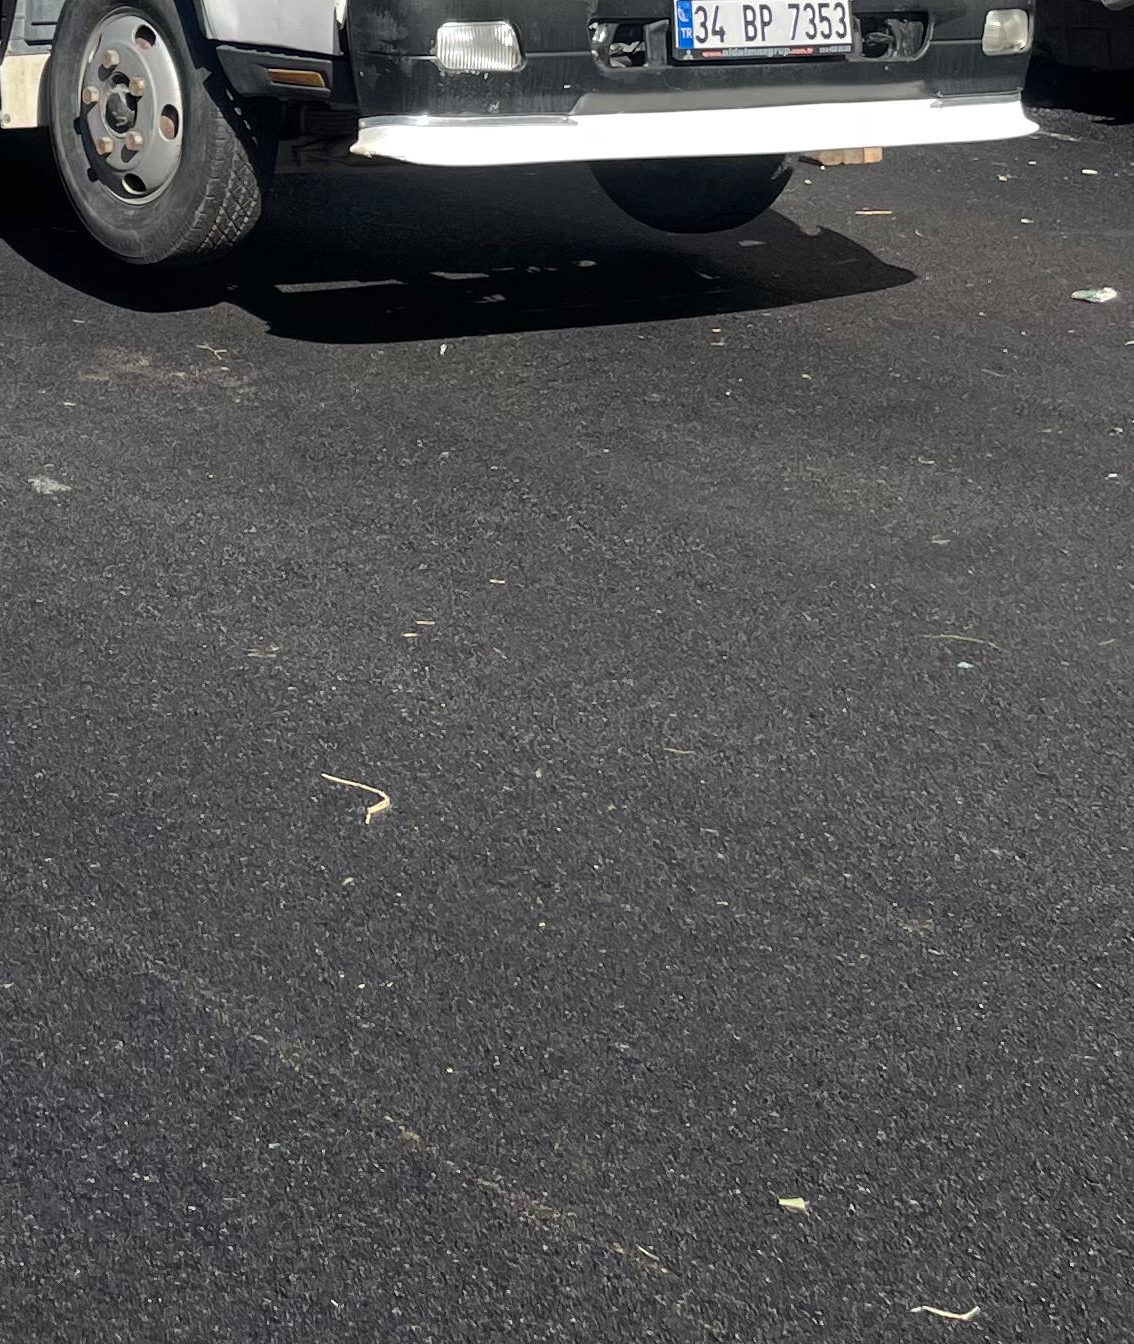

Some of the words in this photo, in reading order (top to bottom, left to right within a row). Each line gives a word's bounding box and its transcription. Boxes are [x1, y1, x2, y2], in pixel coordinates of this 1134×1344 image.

[681, 27, 693, 39] TR
[694, 5, 726, 43] 34
[742, 4, 773, 42] BP
[787, 2, 847, 40] 7353
